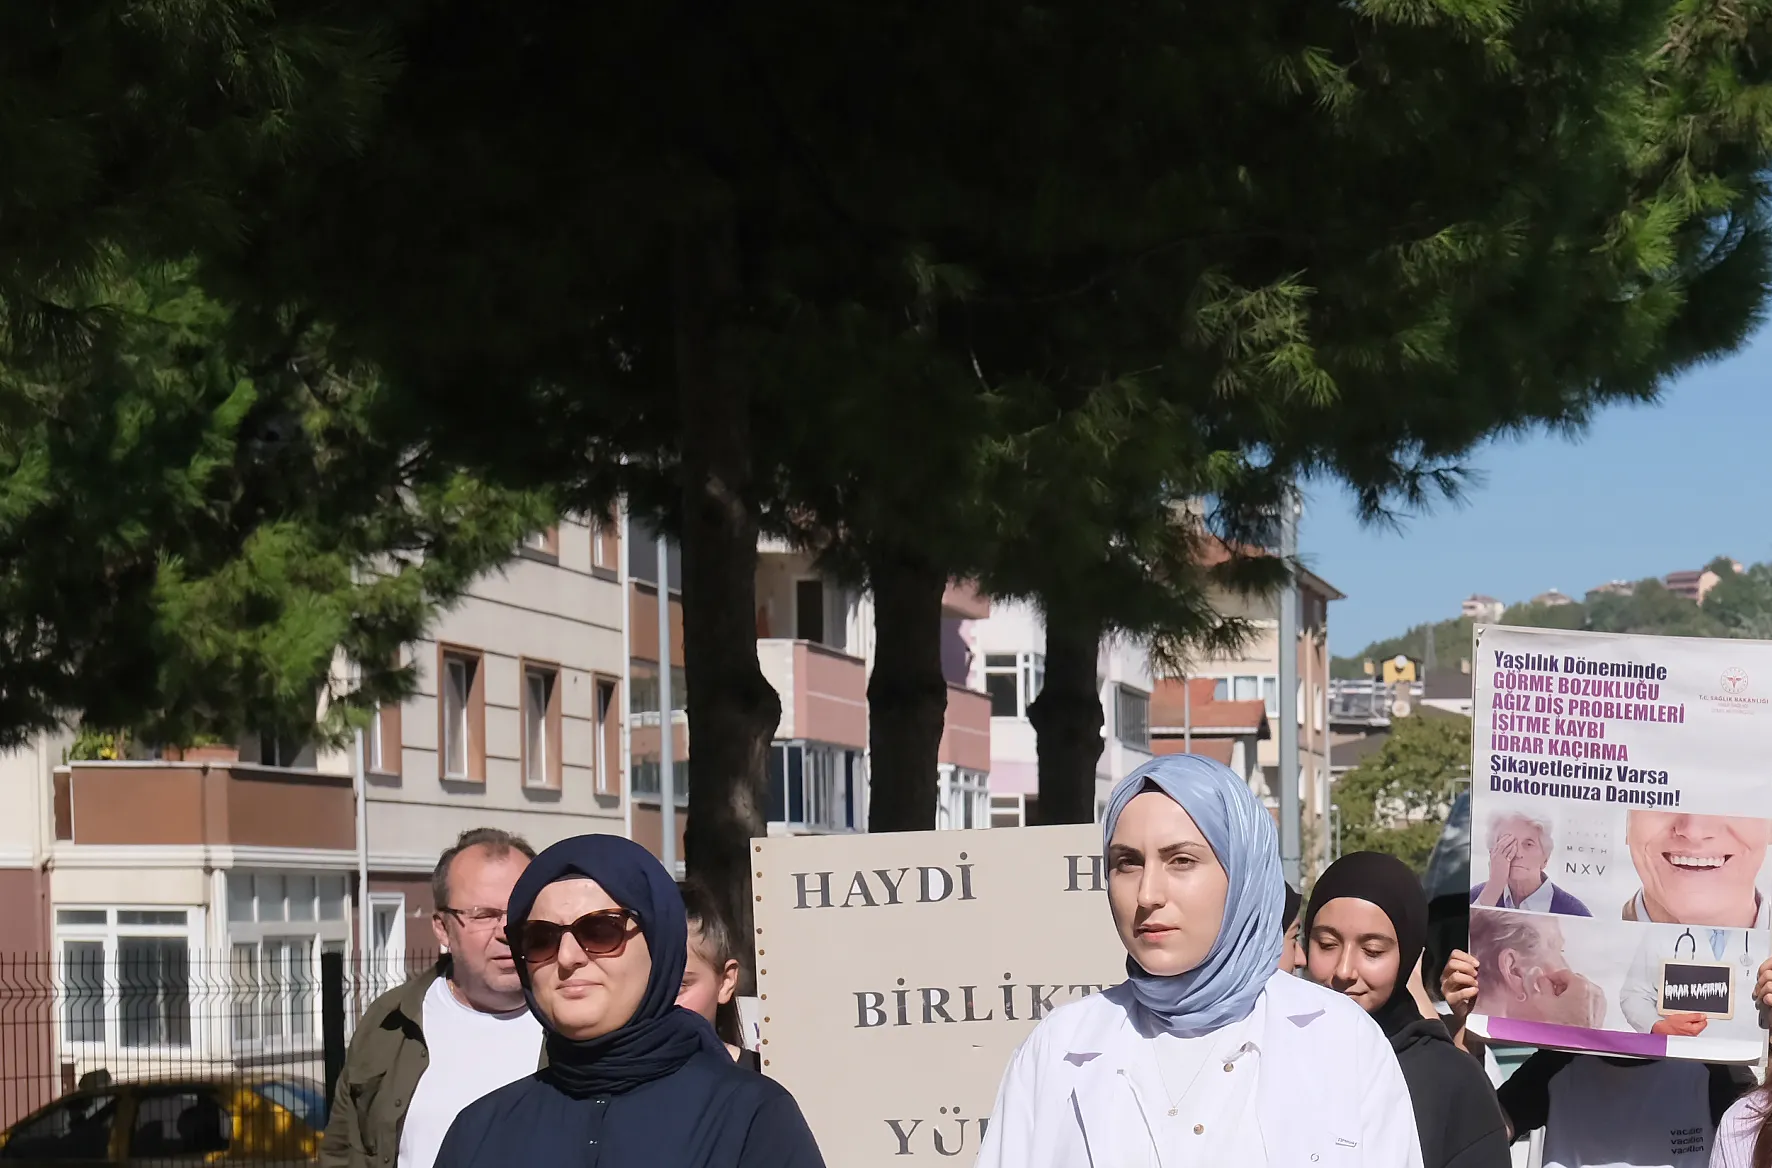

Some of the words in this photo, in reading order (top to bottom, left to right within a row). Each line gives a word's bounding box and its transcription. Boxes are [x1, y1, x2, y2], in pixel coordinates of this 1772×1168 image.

[1493, 650, 1559, 673] Yaşlılık
[1563, 656, 1667, 681] Döneminde
[1493, 669, 1554, 693] GÖRME
[1558, 679, 1660, 701] BOZUKLUĞU
[1492, 690, 1531, 712] AĞIZ
[1535, 694, 1564, 718] DİŞ
[1568, 698, 1685, 724] PROBLEMLERİ
[1492, 710, 1550, 735] İŞİTME
[1555, 718, 1605, 739] KAYBI
[1491, 731, 1544, 754] İDRAR
[1548, 738, 1629, 762] KAÇIRMA
[1490, 754, 1613, 782] Şikayetleriniz
[1616, 765, 1668, 785] Varsa
[1490, 775, 1601, 801] Doktorunuza
[1606, 785, 1681, 808] Danışın!
[791, 852, 977, 909] HAYDİ
